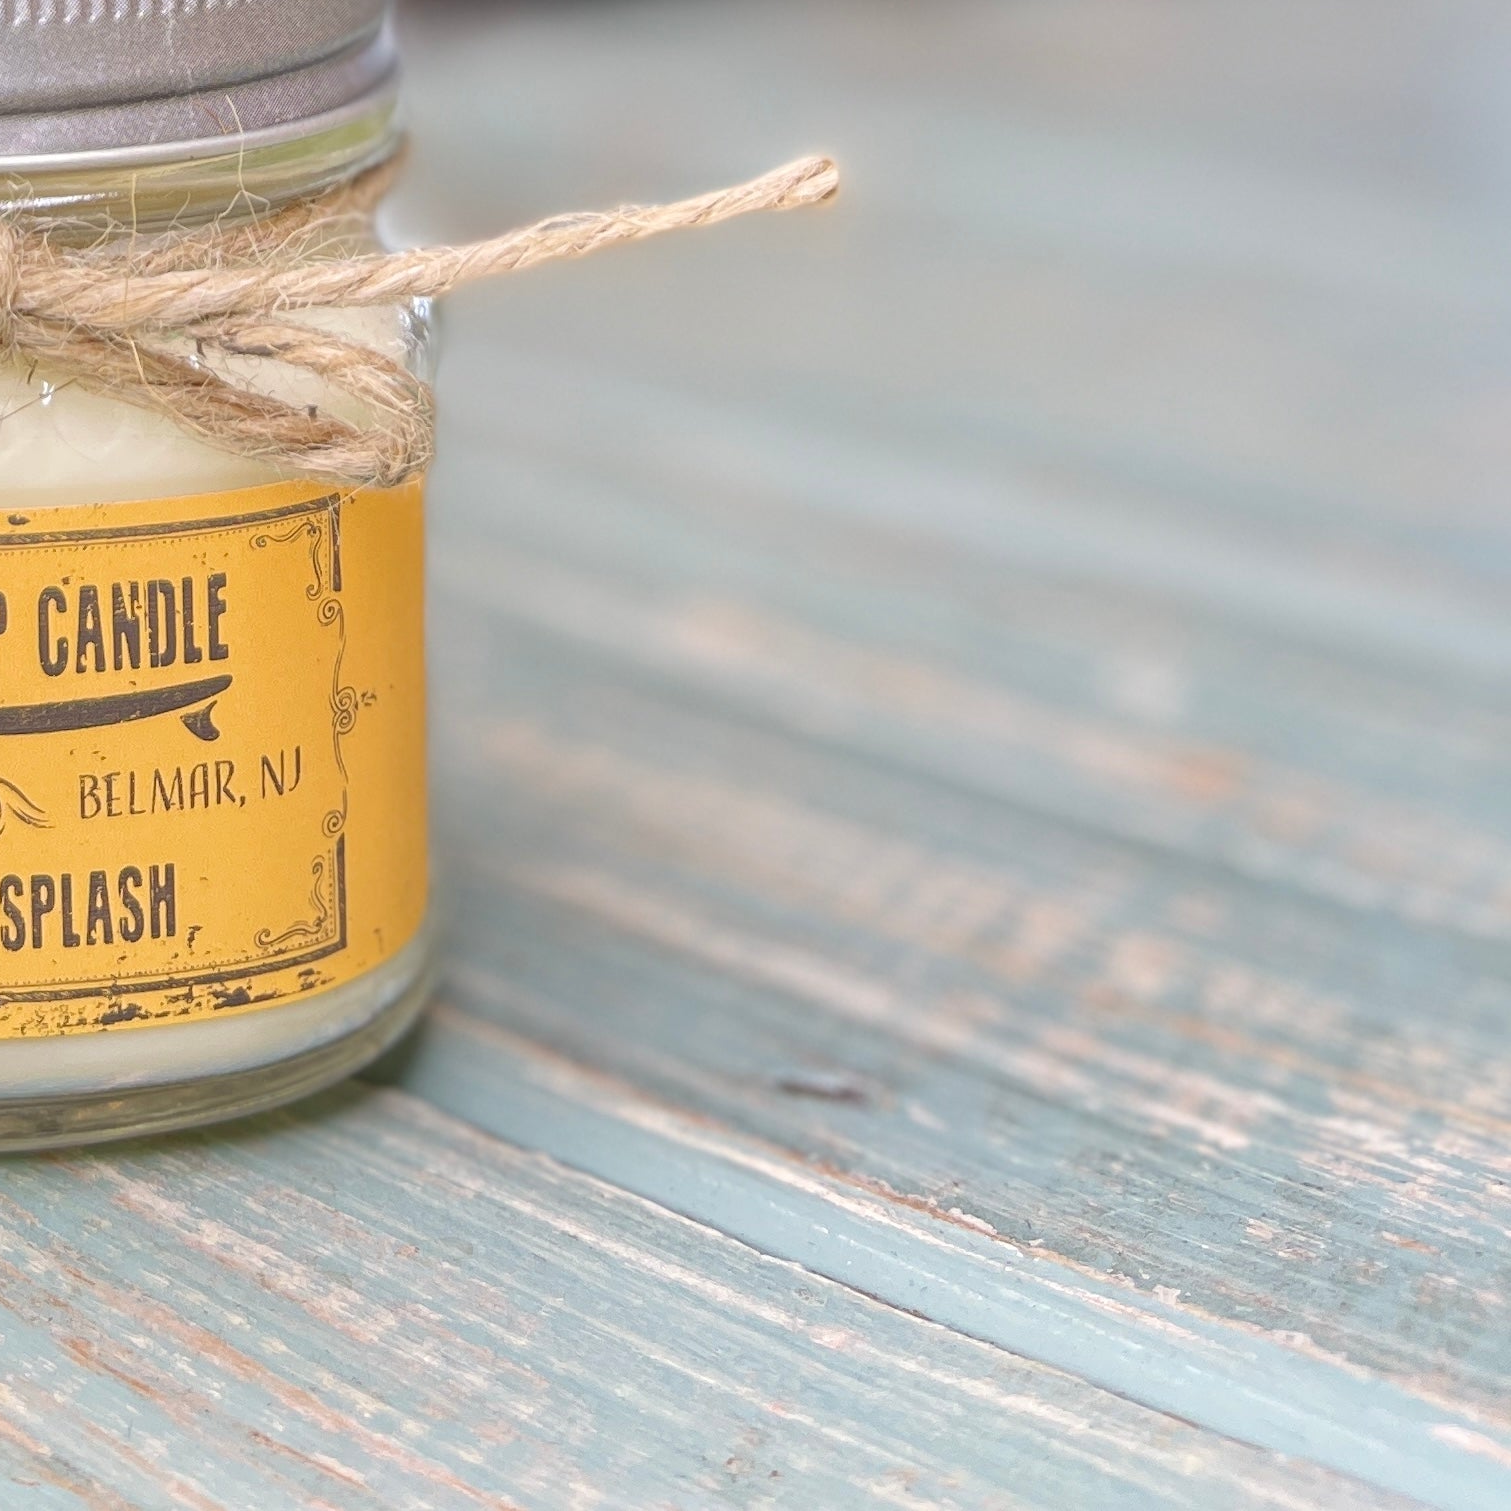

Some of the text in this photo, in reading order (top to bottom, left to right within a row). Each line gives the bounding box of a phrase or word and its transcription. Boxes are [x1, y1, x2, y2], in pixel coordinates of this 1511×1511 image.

[37, 572, 230, 676] CANDLE
[78, 745, 303, 818] BELMAR, NJ
[0, 863, 176, 952] SPLASH
